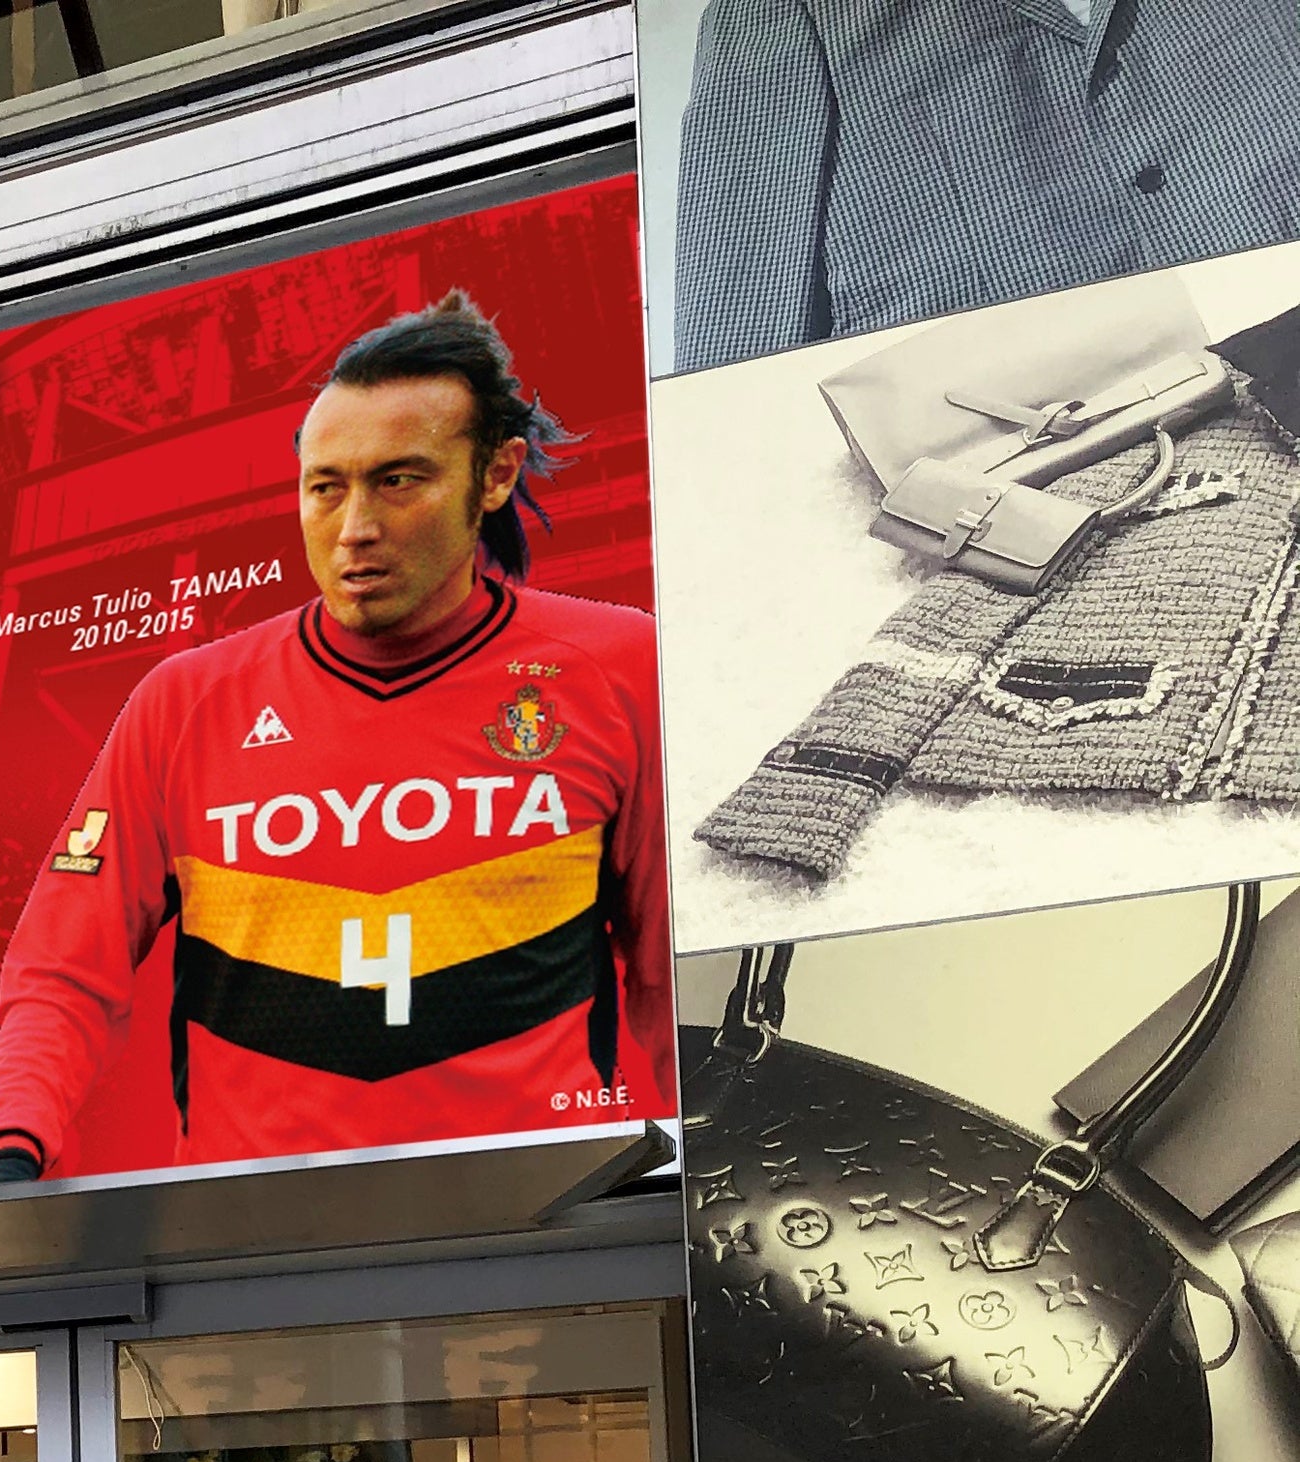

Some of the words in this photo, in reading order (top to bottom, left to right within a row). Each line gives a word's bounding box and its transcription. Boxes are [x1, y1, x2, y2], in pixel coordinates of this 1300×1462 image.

[92, 587, 152, 618] Tulio
[169, 559, 283, 604] TANAKA
[70, 605, 196, 652] 2010-2015
[206, 773, 570, 863] TOYOTA
[340, 913, 412, 1026] 4
